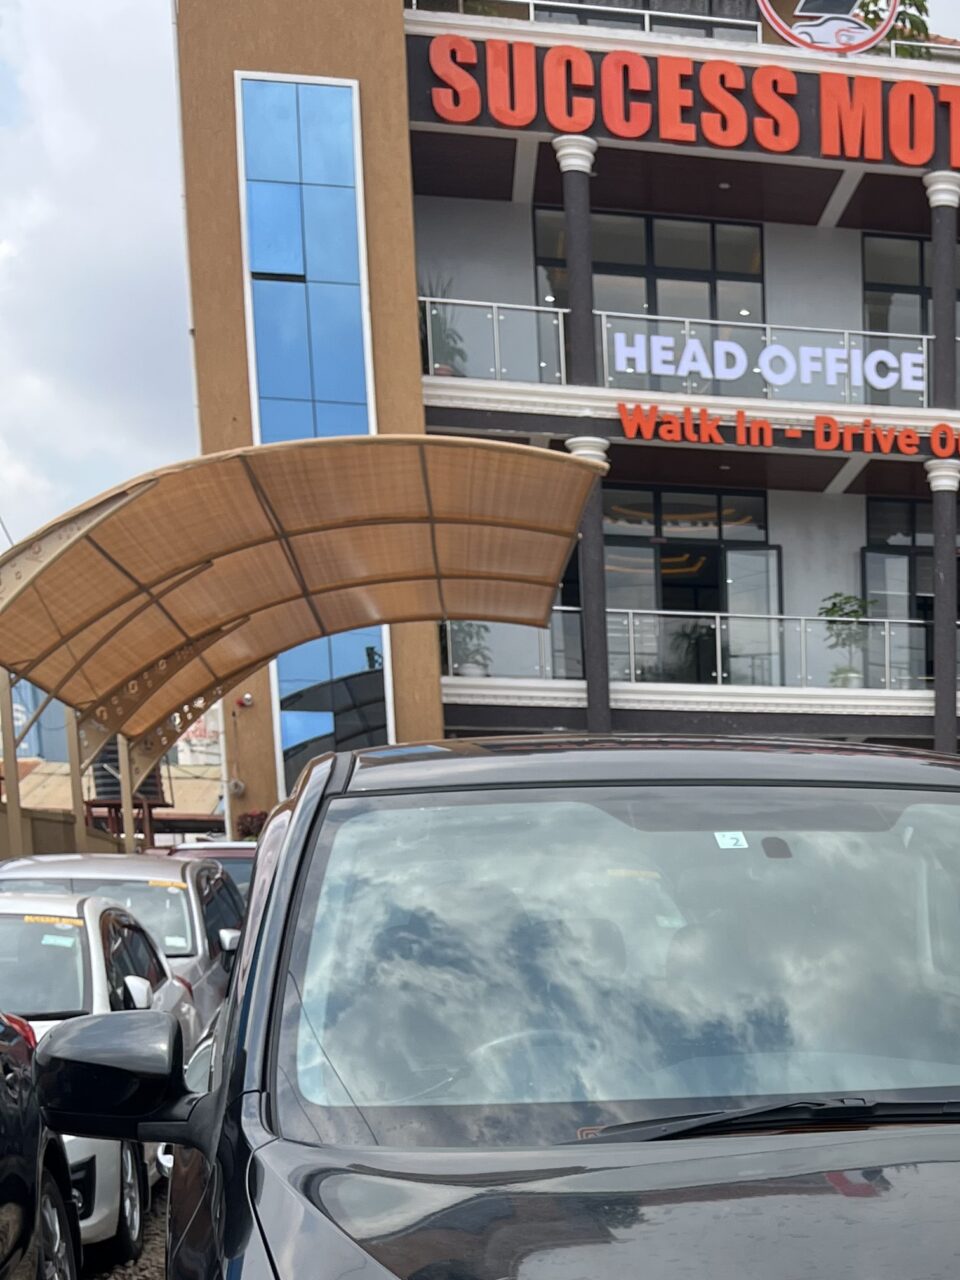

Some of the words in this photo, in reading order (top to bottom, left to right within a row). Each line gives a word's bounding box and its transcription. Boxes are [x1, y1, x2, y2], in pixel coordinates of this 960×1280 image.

[428, 33, 800, 153] SUCCESS
[614, 332, 748, 381] HEAD
[758, 344, 924, 391] OFFICE
[617, 403, 724, 445] Walk
[735, 409, 773, 447] In
[814, 415, 920, 455] Drive
